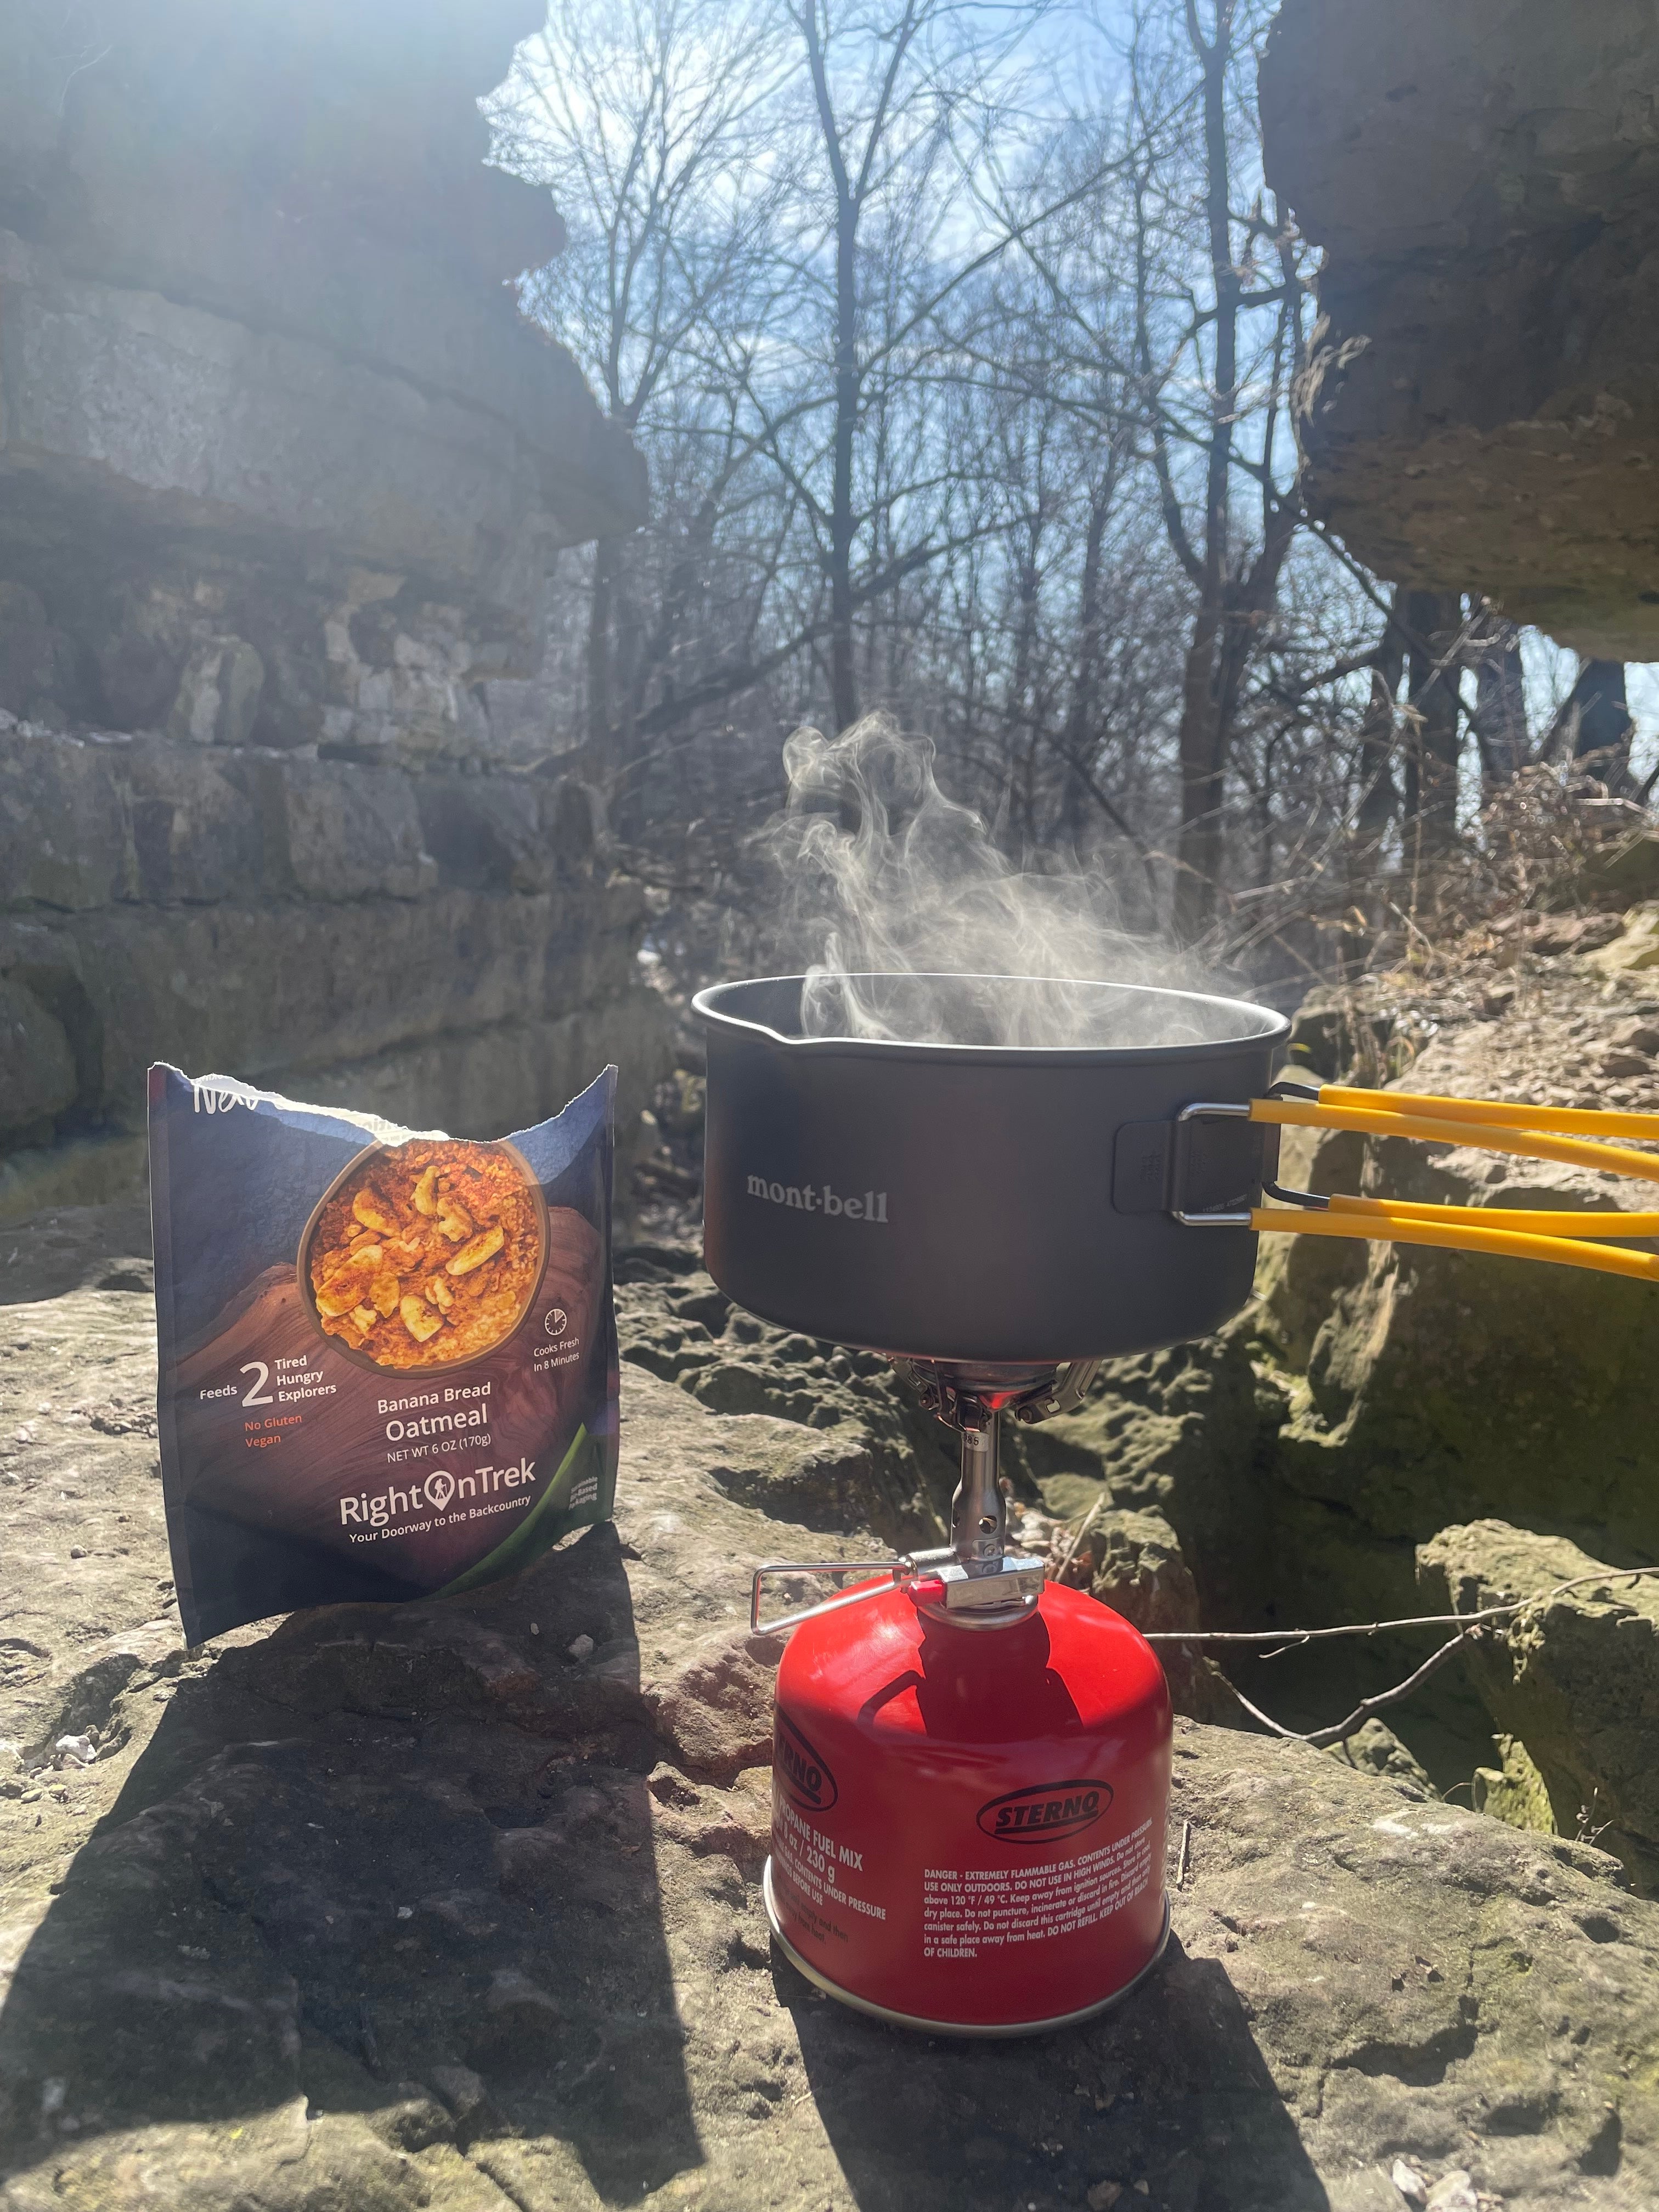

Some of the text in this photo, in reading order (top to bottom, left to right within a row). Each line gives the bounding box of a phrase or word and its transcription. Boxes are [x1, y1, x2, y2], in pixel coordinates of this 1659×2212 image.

[275, 1355, 307, 1370] Tired
[534, 1337, 579, 1357] Cooks Fresh
[534, 1352, 580, 1372] In 8 Minutes
[200, 1361, 273, 1407] Feeds 2
[276, 1371, 324, 1386] Hungry
[278, 1384, 337, 1402] Explorers
[377, 1381, 490, 1414] Banana Bread
[245, 1415, 302, 1431] No Gluten
[386, 1403, 487, 1441] Oatmeal
[245, 1435, 281, 1448] Vegan
[387, 1433, 491, 1463] NET WT 6 OZ (170g)
[349, 1495, 531, 1543] Your Doorway to the Backcountry
[996, 1791, 1100, 1827] STERNO
[780, 1793, 810, 1842] PROPANE
[813, 1830, 836, 1859] FUEL
[839, 1846, 863, 1872] MIX
[784, 1821, 788, 1839] 8
[789, 1833, 798, 1851] oz
[806, 1845, 825, 1872] 230
[828, 1865, 835, 1883] g
[924, 1869, 957, 1880] DANGER
[965, 1870, 1009, 1880] EXTREMELY
[1011, 1864, 1056, 1878] FLAMMABLE
[1058, 1860, 1075, 1871] GAS.
[1077, 1846, 1110, 1865] CONTENTS
[1111, 1835, 1130, 1852] UNDER
[924, 1881, 938, 1891] USE
[941, 1882, 962, 1892] ONLY
[964, 1882, 1012, 1892] OUTDOORS.
[1015, 1881, 1027, 1890] DO
[1029, 1877, 1046, 1888] NOT
[1048, 1874, 1062, 1885] USE
[1064, 1872, 1071, 1882] IN
[1074, 1865, 1091, 1879] HIGH
[1092, 1855, 1115, 1872] WINDS.
[1116, 1852, 1124, 1861] Do
[1125, 1844, 1133, 1856] not
[793, 1871, 811, 1897] BEFORE
[812, 1889, 823, 1906] USE
[795, 1858, 822, 1889] CONTENTS
[823, 1882, 847, 1905] UNDER
[848, 1895, 886, 1920] PRESSURE
[924, 1894, 948, 1904] above
[951, 1895, 966, 1905] 120
[968, 1895, 975, 1905] °F
[977, 1894, 982, 1906] /
[984, 1895, 995, 1904] 49
[1010, 1894, 1030, 1904] Keep
[1032, 1891, 1053, 1900] away
[1056, 1886, 1072, 1897] from
[1074, 1877, 1098, 1893] ignition
[1099, 1866, 1121, 1882] sources.
[1123, 1856, 1136, 1870] Store
[1136, 1851, 1141, 1860] in
[924, 1907, 938, 1920] dry
[940, 1908, 962, 1920] place.
[964, 1909, 975, 1917] Do
[978, 1909, 991, 1917] not
[992, 1907, 1029, 1920] puncture,
[1031, 1899, 1066, 1914] incinerate
[1077, 1884, 1101, 1903] discard
[1102, 1884, 1107, 1893] in
[1109, 1879, 1120, 1890] fire.
[1121, 1861, 1139, 1883] Discard
[924, 1921, 955, 1931] canister
[956, 1920, 981, 1933] safely.
[984, 1921, 994, 1930] Do
[996, 1921, 1009, 1929] not
[1011, 1915, 1039, 1928] discard
[1041, 1913, 1054, 1925] this
[1055, 1906, 1086, 1922] cartridge
[1087, 1897, 1101, 1911] until
[1102, 1889, 1120, 1905] empty
[1121, 1880, 1131, 1894] and
[924, 1933, 932, 1944] in
[941, 1934, 957, 1944] safe
[960, 1934, 980, 1947] place
[982, 1936, 1005, 1946] away
[1007, 1932, 1025, 1942] from
[1026, 1930, 1045, 1940] heat.
[1047, 1926, 1059, 1936] DO
[1060, 1920, 1076, 1933] NOT
[1077, 1913, 1098, 1928] REFILL.
[1099, 1904, 1114, 1919] KEEP
[1114, 1896, 1126, 1910] OUT
[1127, 1889, 1134, 1902] OF
[1135, 1877, 1148, 1896] REACH
[924, 1947, 978, 1958] OF CHILDREN.
